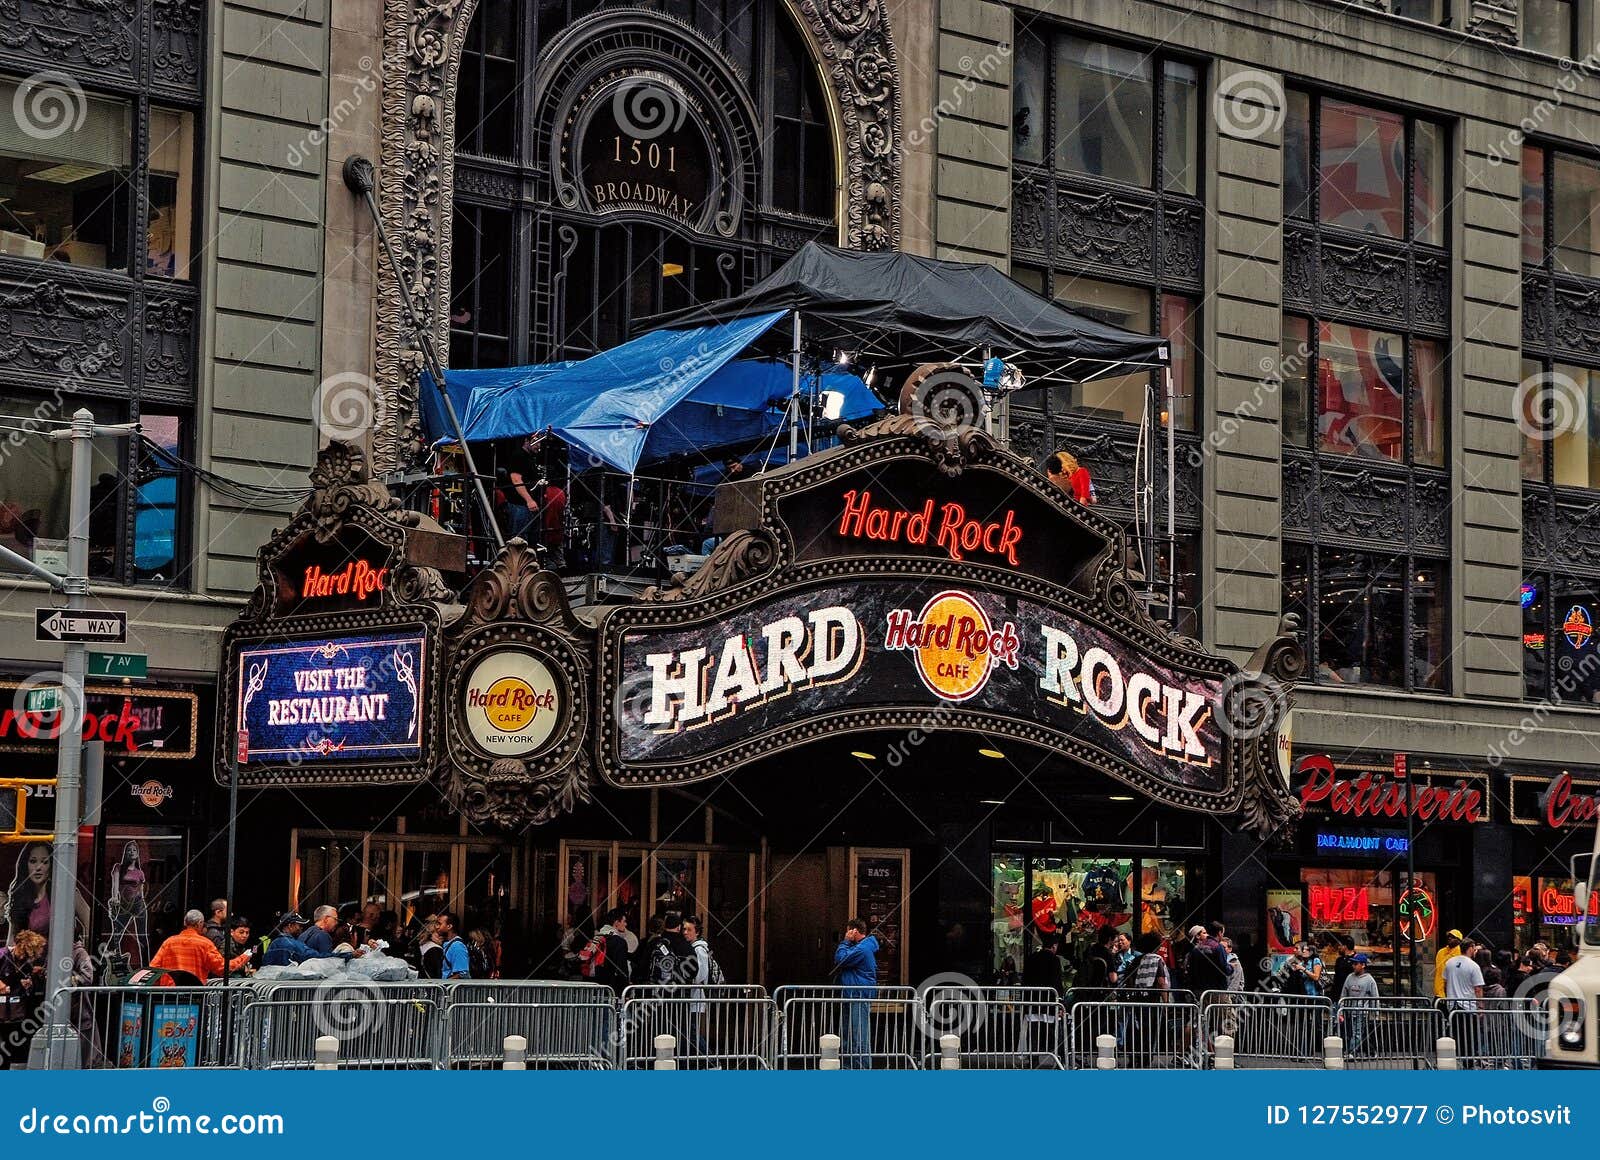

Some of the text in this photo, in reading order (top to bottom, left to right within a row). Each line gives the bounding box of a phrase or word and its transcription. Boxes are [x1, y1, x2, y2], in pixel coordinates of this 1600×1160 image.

[614, 135, 676, 172] 1501
[594, 181, 694, 217] BROADWAY
[839, 489, 1023, 567] Hard Rock
[303, 562, 353, 597] Hard
[50, 619, 115, 633] ONE WAY
[885, 609, 1018, 669] Hard Rock
[102, 654, 131, 673] 7 AV
[644, 606, 863, 732] HARD
[936, 662, 969, 680] CAFE
[294, 666, 366, 693] VISIT THE
[1039, 624, 1209, 764] ROCK
[37, 689, 46, 709] 43
[268, 693, 390, 726] RESTAURANT
[468, 687, 555, 711] Hard Rock
[50, 697, 141, 752] ock
[498, 714, 521, 722] CAFE
[486, 735, 534, 743] NEW YORK
[131, 784, 173, 799] Hard Rock
[1298, 754, 1481, 824] Patisserie
[1317, 834, 1380, 850] PARAMOUNT
[867, 868, 890, 877] EATS
[1310, 885, 1370, 922] PIZZA
